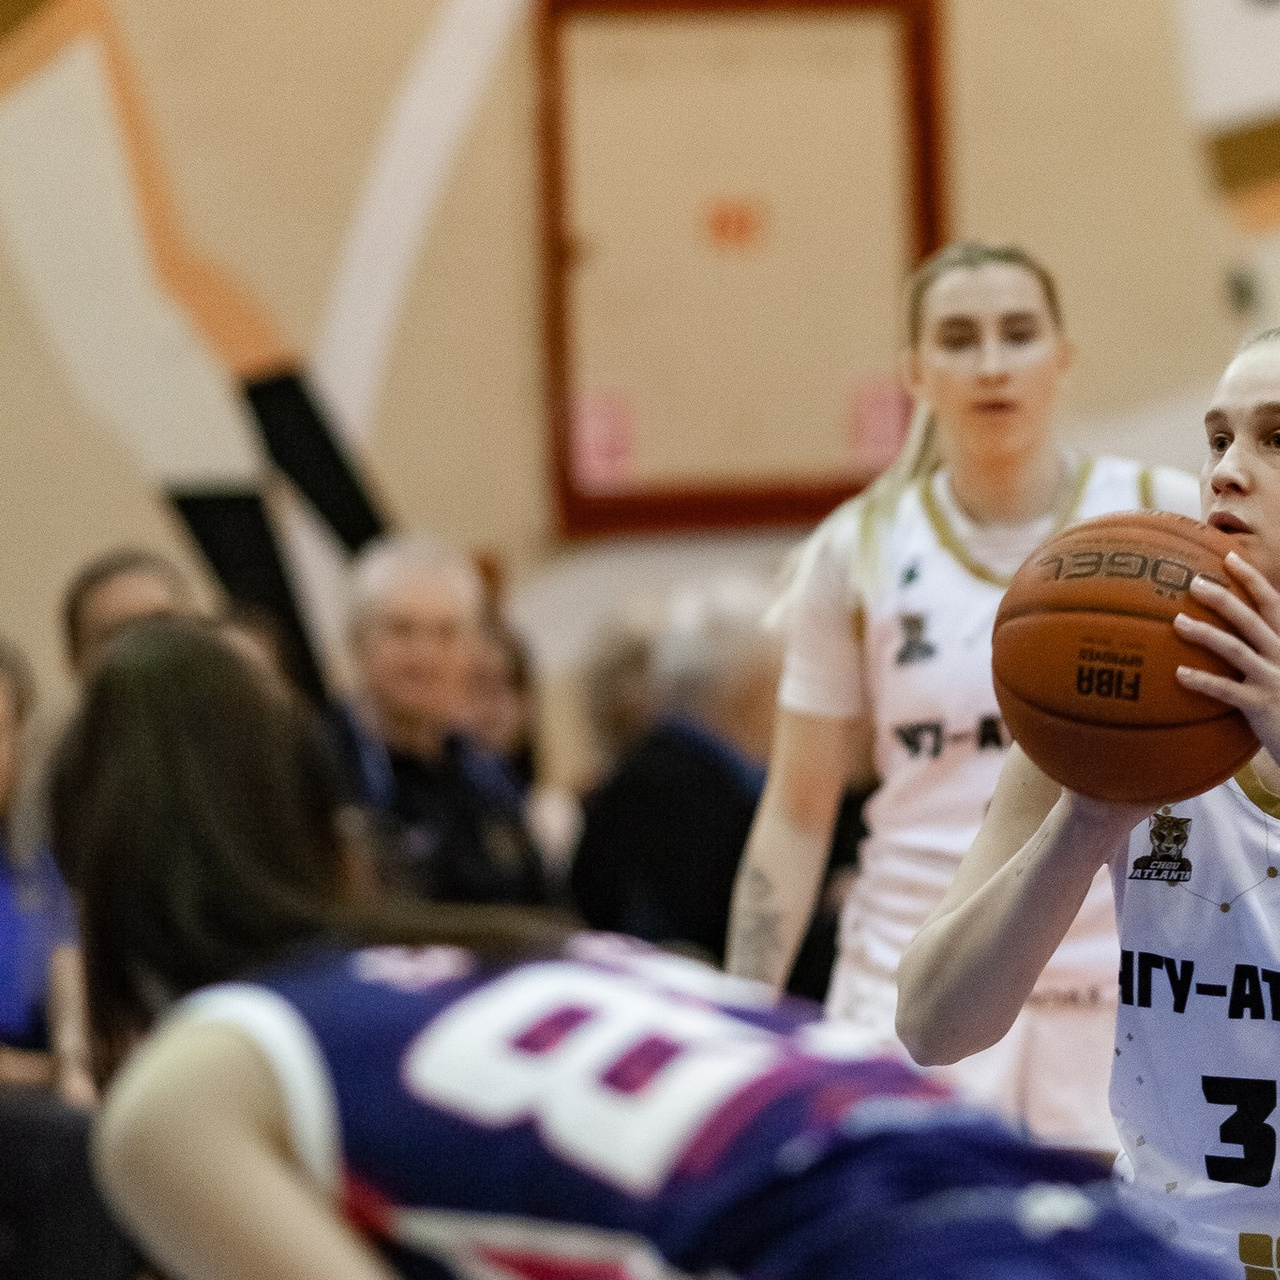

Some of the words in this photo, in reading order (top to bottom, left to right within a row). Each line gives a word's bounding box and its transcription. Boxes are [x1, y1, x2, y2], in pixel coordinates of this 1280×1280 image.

[1036, 551, 1229, 600] ÖGEL
[1076, 665, 1142, 702] FIBA
[1132, 869, 1191, 880] ATLANTA
